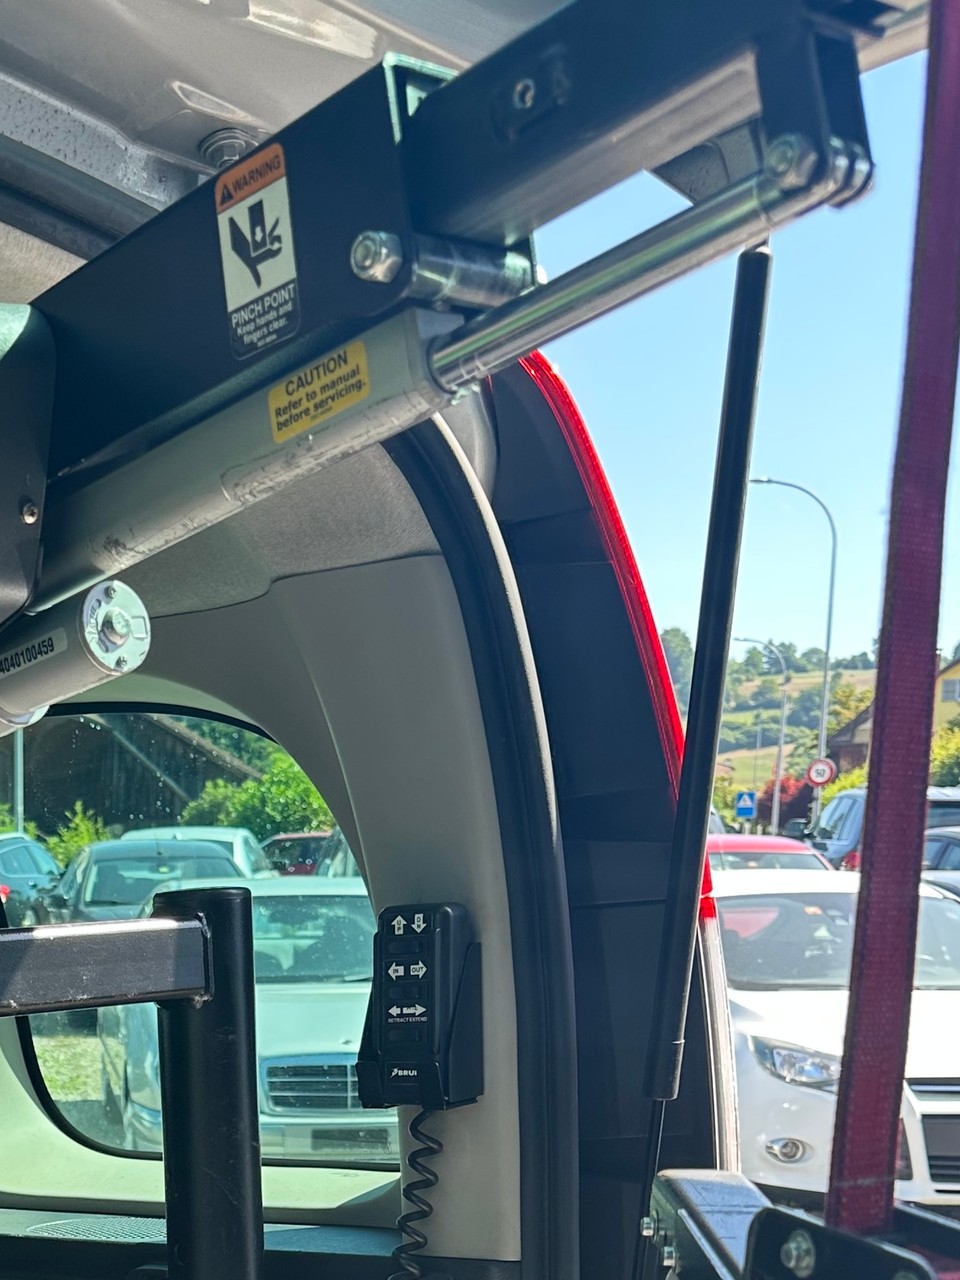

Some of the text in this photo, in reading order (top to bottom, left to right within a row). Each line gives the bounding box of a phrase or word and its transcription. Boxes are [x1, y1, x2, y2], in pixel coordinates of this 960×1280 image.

[232, 155, 282, 193] WARNING
[231, 283, 295, 328] PINCH POINT
[236, 301, 293, 337] Keep hands and
[243, 326, 268, 345] fingers
[268, 317, 288, 332] clear.
[275, 397, 303, 419] Refer
[305, 390, 317, 403] to
[319, 363, 360, 396] manual
[285, 349, 348, 397] CAUTION
[276, 406, 311, 432] before
[313, 378, 366, 413] servicing.
